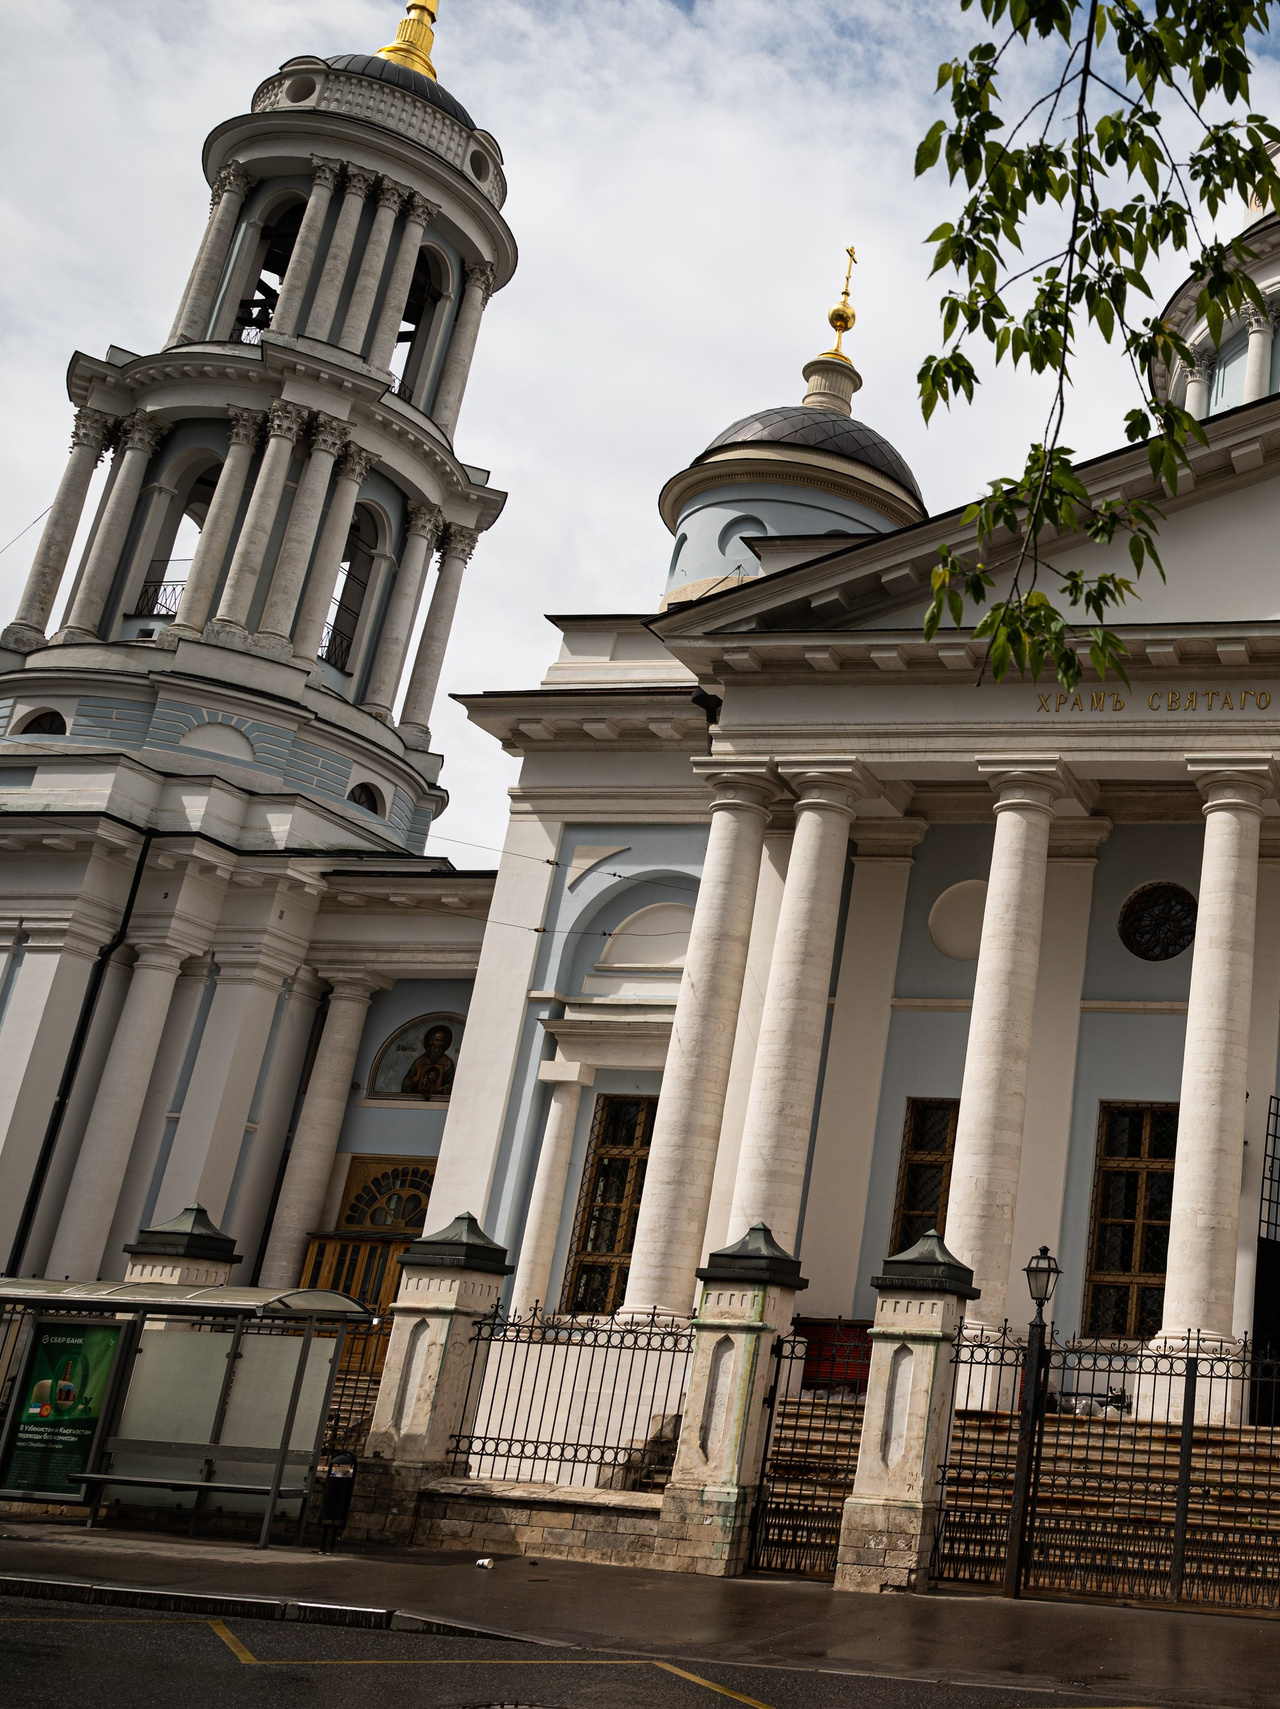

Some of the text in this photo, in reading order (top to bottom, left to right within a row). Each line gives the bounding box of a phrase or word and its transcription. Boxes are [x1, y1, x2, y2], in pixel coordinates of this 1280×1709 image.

[1037, 690, 1125, 712] ХРАМЪ
[1148, 690, 1271, 711] СВЯТАГО
[24, 1424, 54, 1432] Узбекистан
